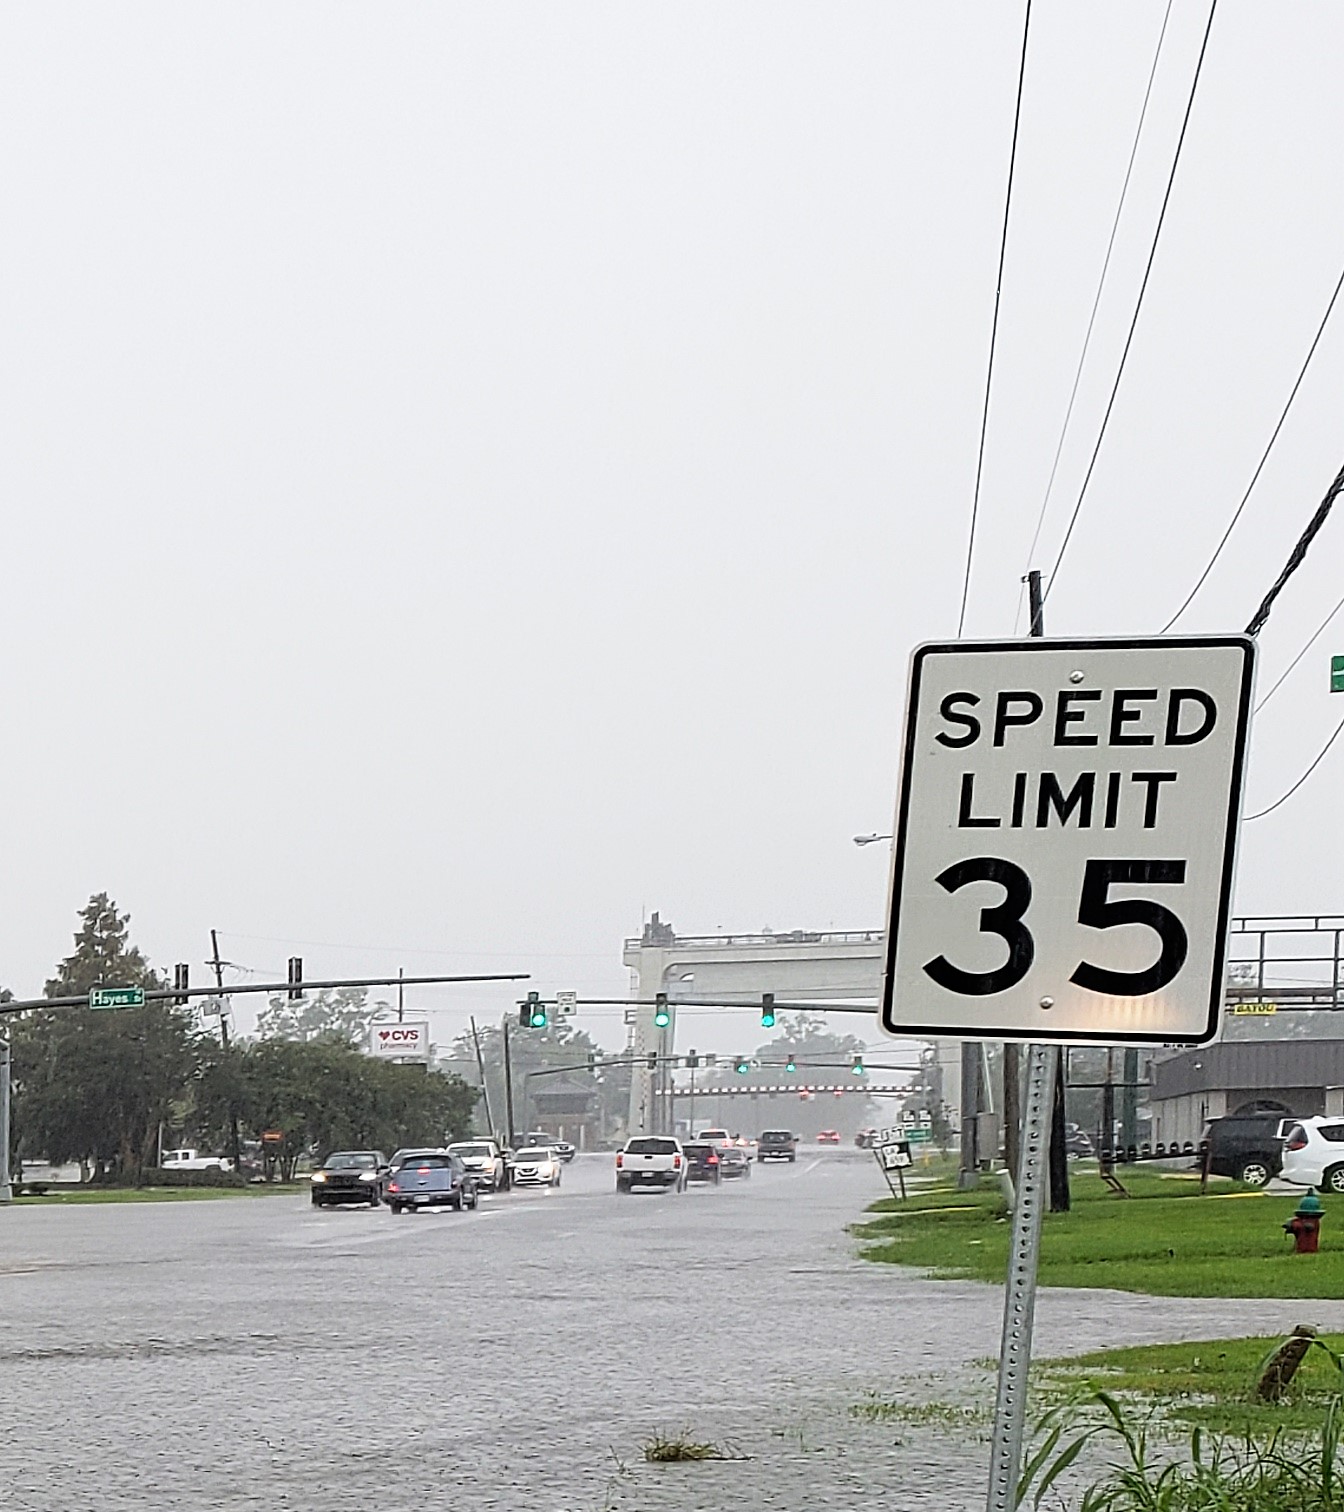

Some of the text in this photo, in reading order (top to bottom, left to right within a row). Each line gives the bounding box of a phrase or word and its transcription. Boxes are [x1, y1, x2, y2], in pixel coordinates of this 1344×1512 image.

[934, 688, 1218, 749] SPEED
[958, 771, 1178, 829] LIMIT
[922, 856, 1188, 997] 35
[92, 990, 129, 1006] Hayes
[392, 1030, 419, 1041] CVS
